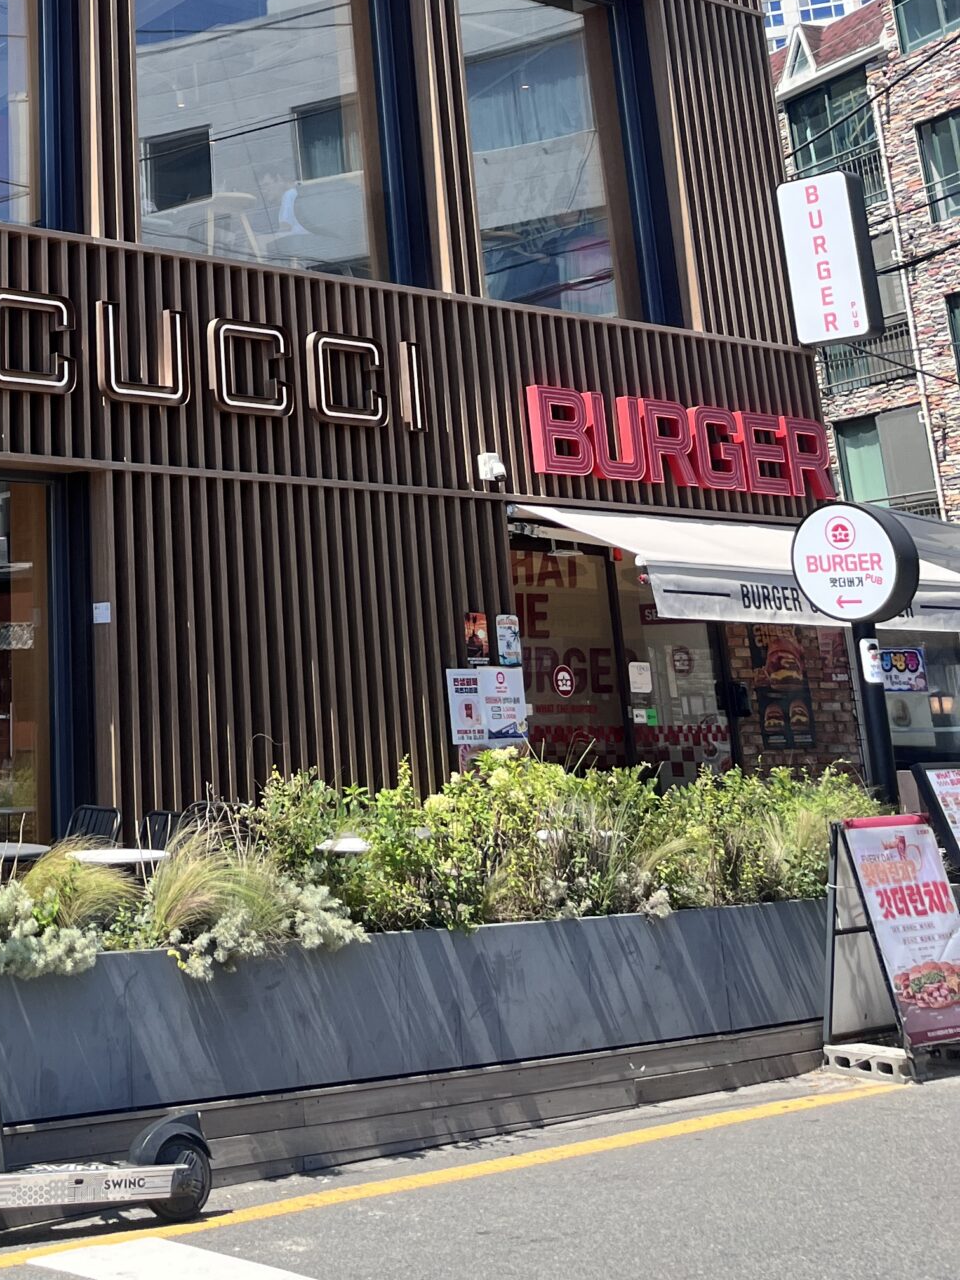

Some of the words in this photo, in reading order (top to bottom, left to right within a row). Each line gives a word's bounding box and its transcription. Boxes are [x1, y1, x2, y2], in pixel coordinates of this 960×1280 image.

[805, 184, 839, 332] BURGER
[850, 301, 860, 328] PUB
[526, 385, 836, 500] BURGER
[806, 553, 883, 574] BURGER
[829, 577, 865, 588] 왓더버거
[865, 573, 883, 586] PUB
[740, 583, 803, 613] BURGER
[103, 1177, 147, 1191] SWING
